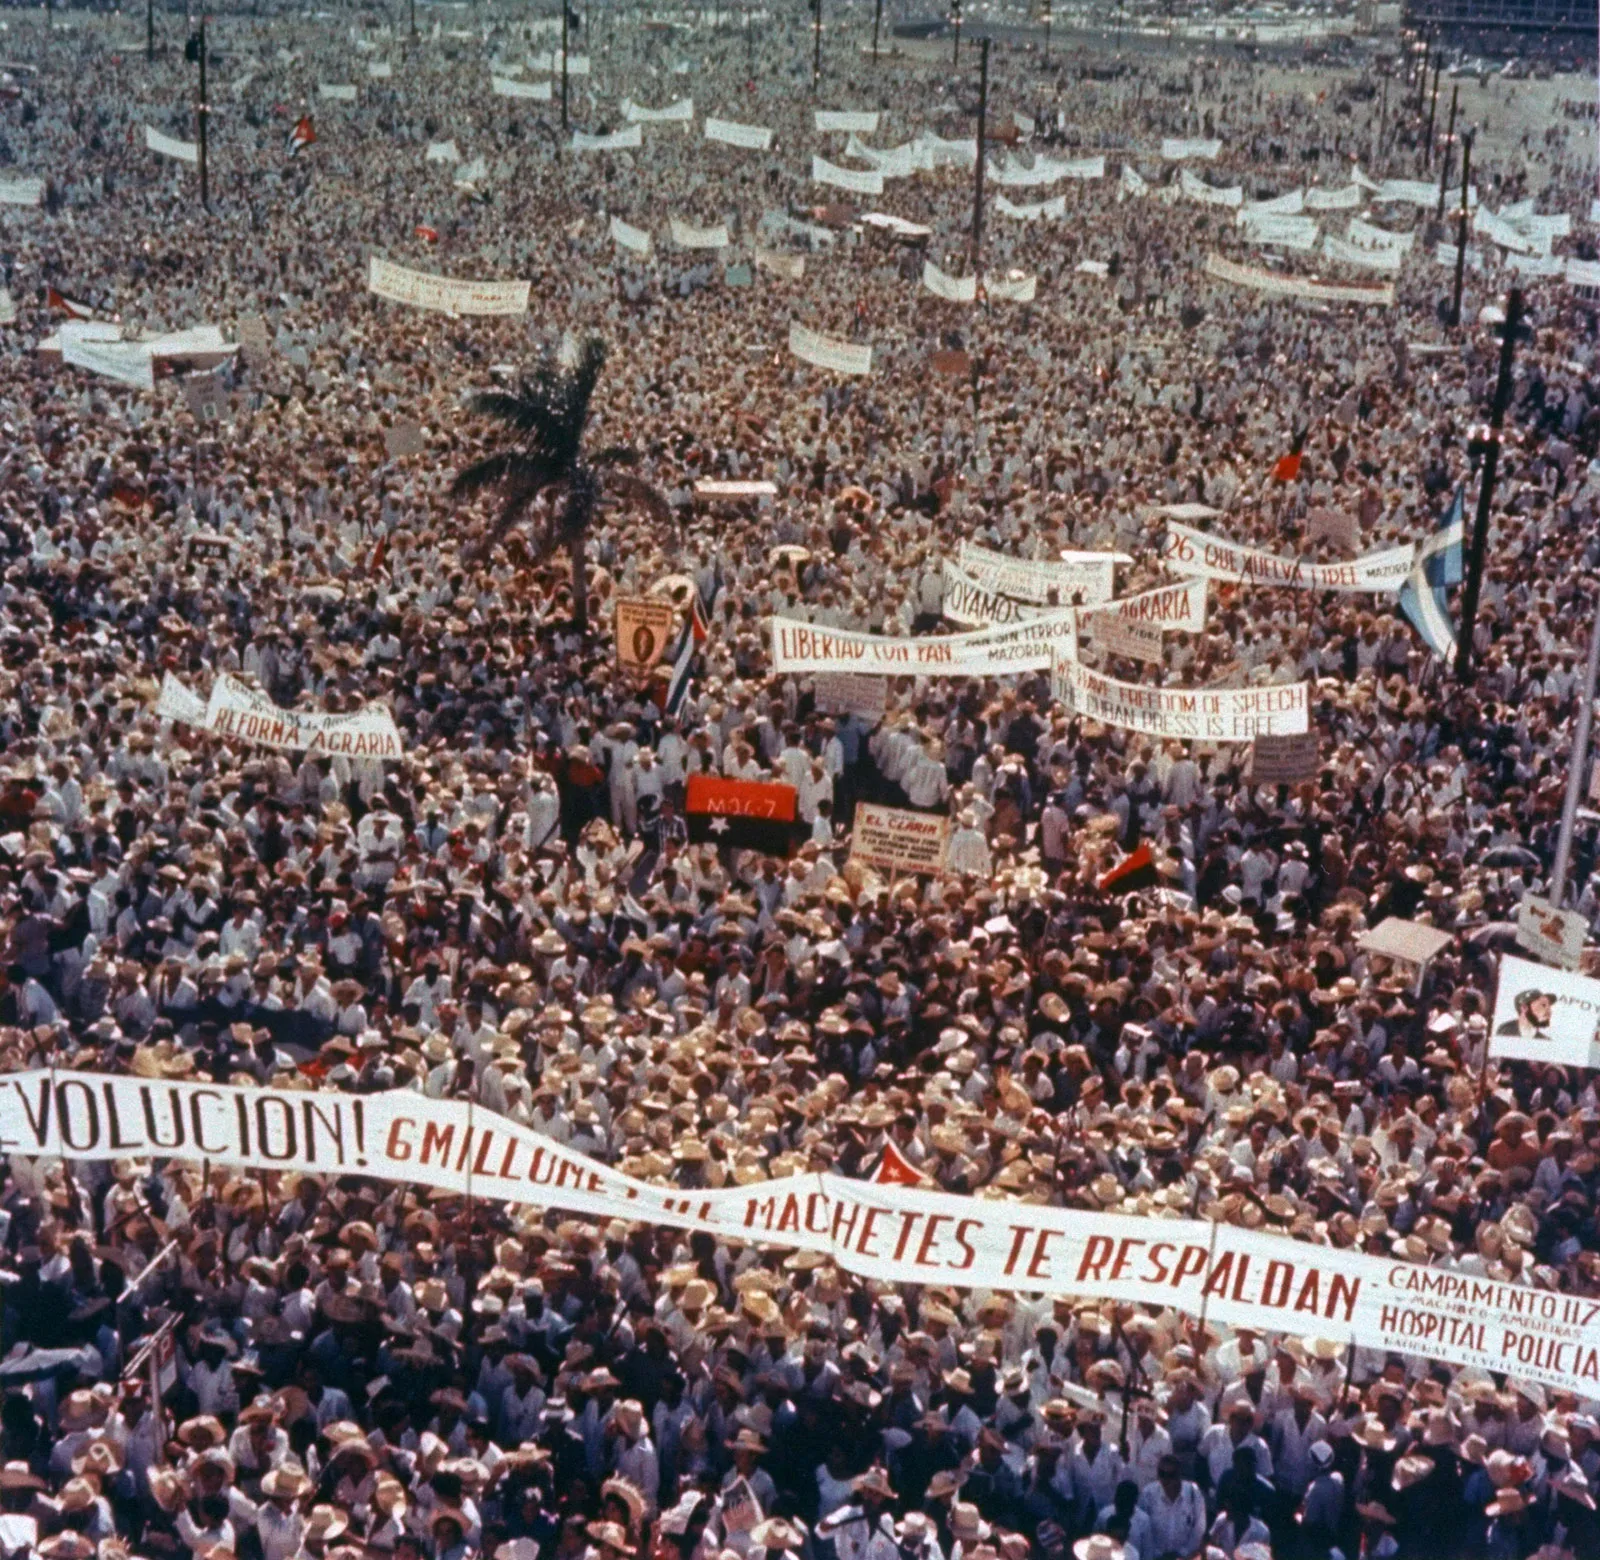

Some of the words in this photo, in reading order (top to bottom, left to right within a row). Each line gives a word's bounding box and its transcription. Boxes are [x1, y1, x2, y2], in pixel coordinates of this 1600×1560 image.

[1165, 532, 1194, 562] 26
[781, 628, 864, 660] LIBERTAD
[988, 643, 1051, 660] MAZORRA
[1232, 688, 1302, 714] SPEECH
[214, 707, 300, 745] REFORMA
[1142, 709, 1198, 736] PRESS
[1207, 717, 1224, 736] IS
[743, 1192, 984, 1269] MACHETES
[1003, 1225, 1065, 1278] TE
[1075, 1235, 1361, 1322] RESPALDAN
[1388, 1266, 1556, 1319] CAMPAMENTO
[1380, 1304, 1487, 1352] HOSPITAL
[1502, 1330, 1600, 1381] POLICIA
